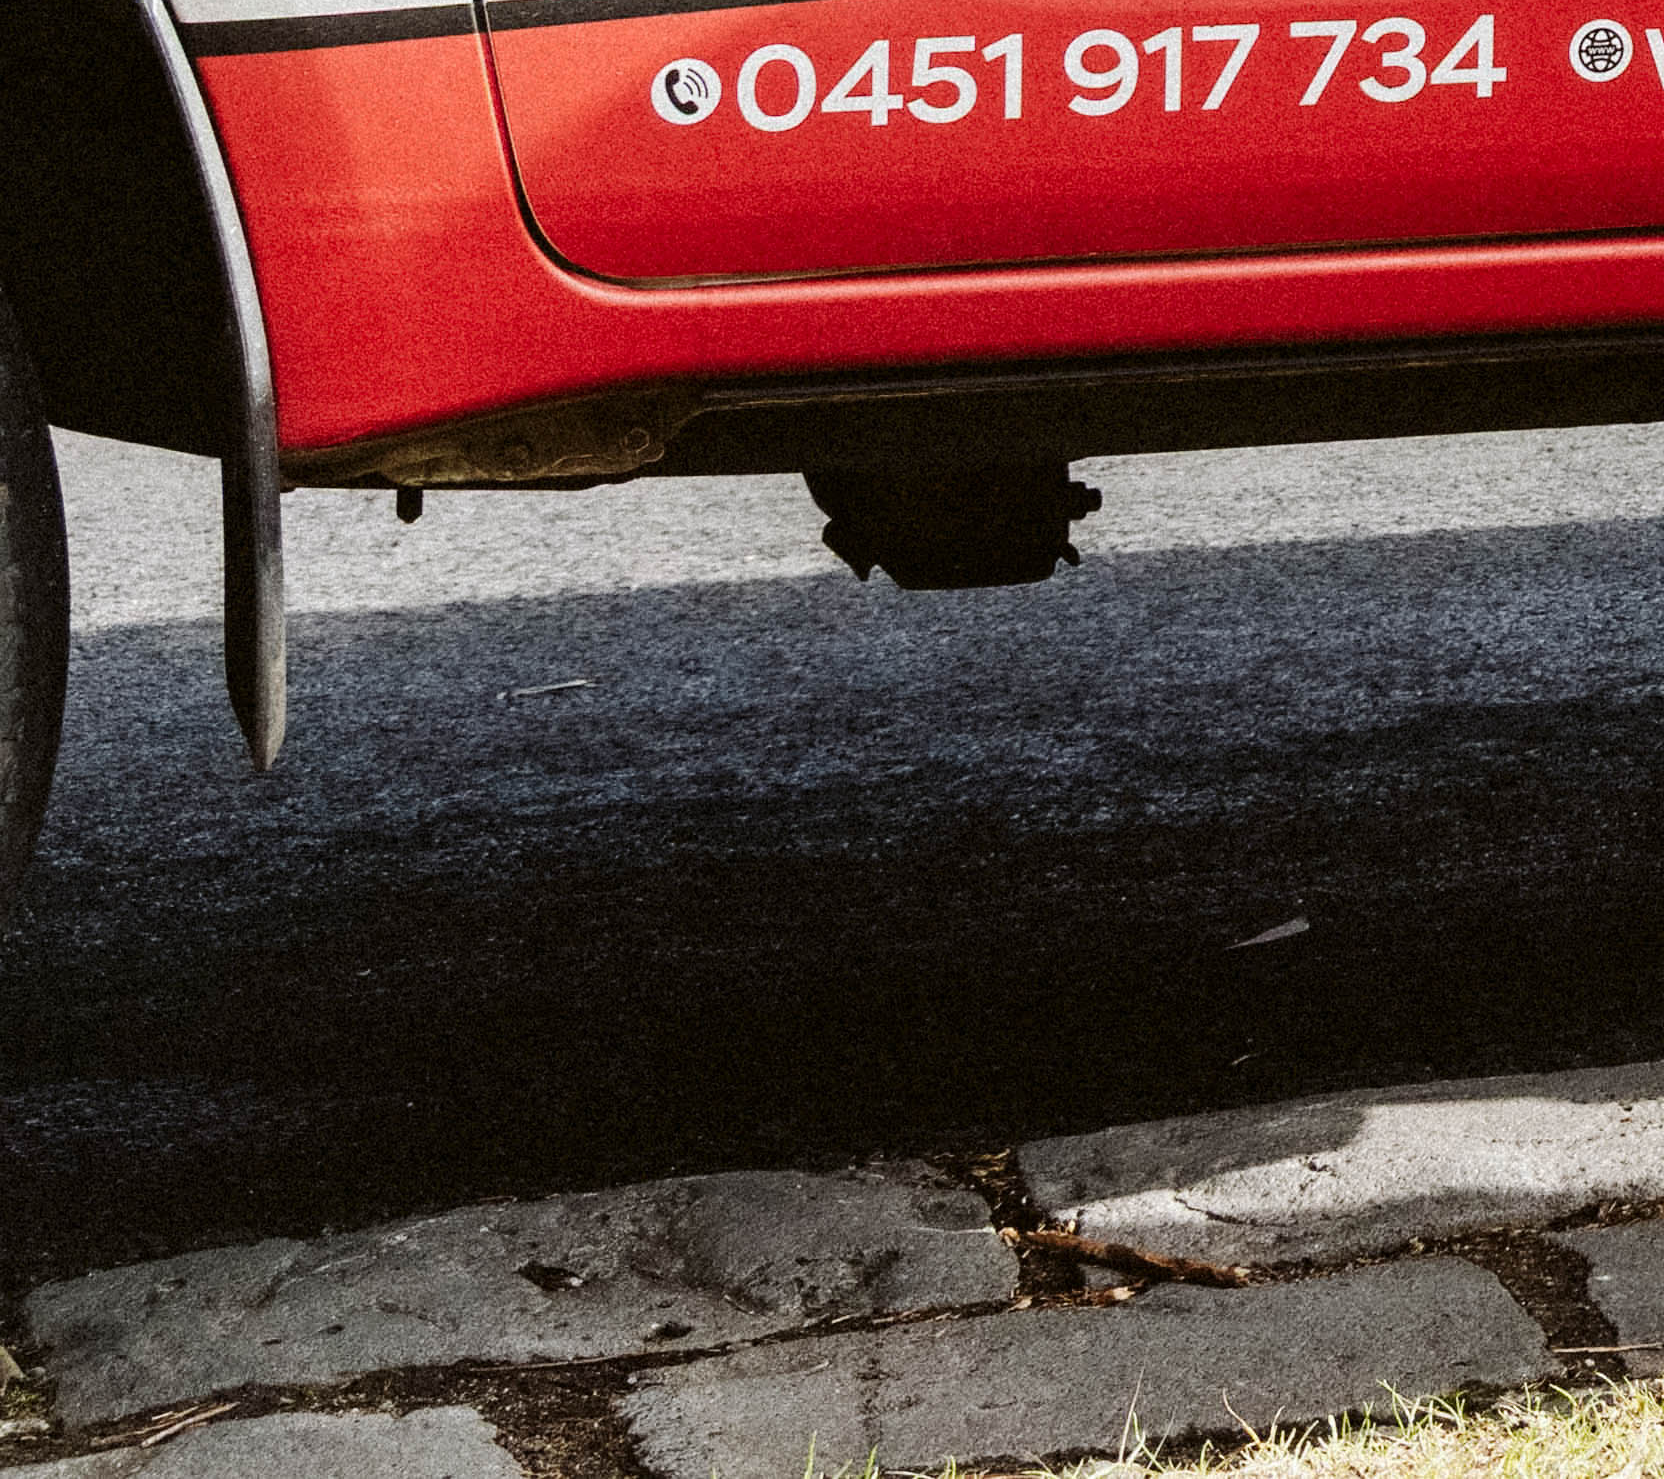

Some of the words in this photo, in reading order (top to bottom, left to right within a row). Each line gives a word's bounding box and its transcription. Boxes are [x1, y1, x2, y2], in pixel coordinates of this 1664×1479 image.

[737, 33, 1023, 132] 0451
[1064, 22, 1260, 117] 917
[1290, 15, 1507, 107] 734
